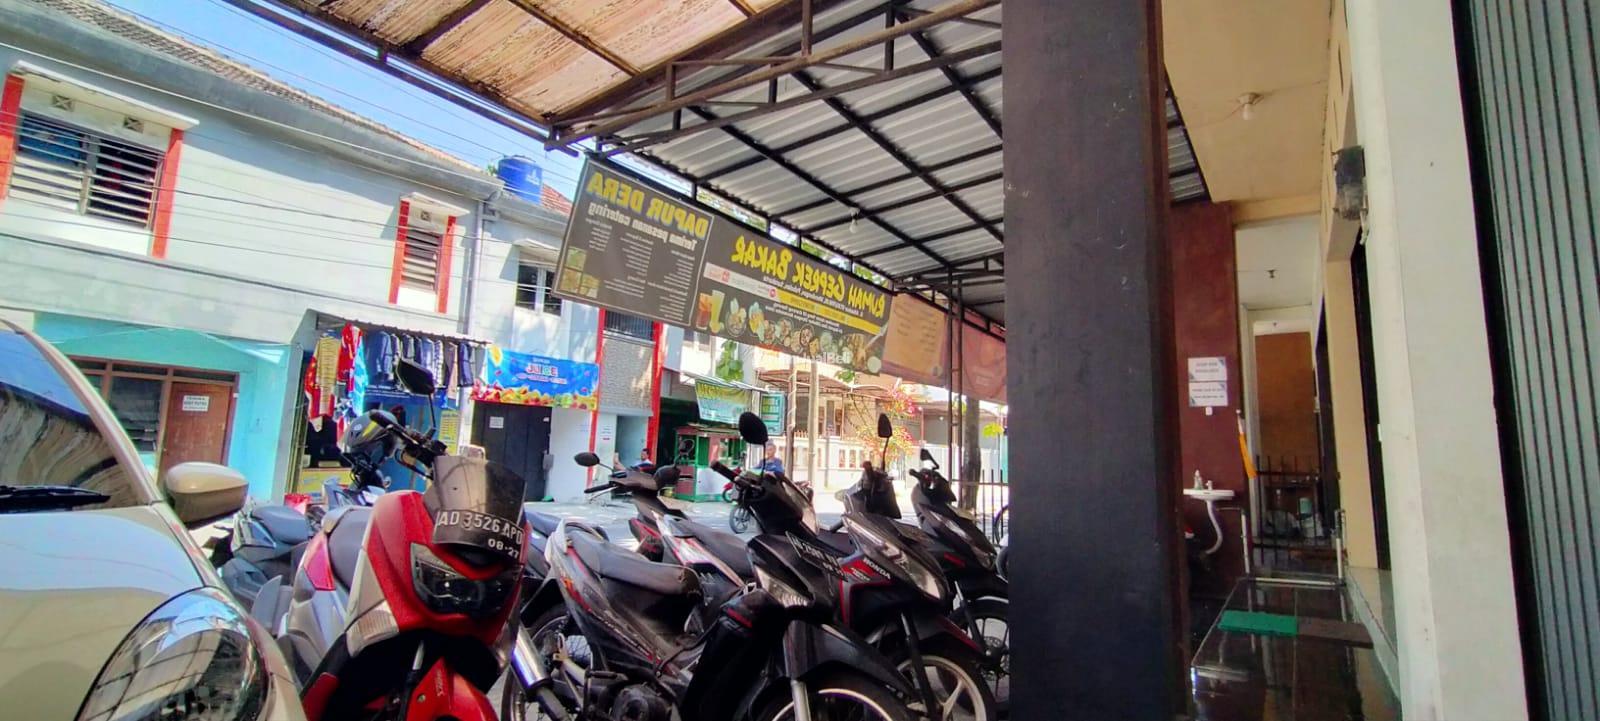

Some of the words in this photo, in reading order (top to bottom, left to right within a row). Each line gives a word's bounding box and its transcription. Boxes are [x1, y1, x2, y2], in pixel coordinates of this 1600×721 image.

[440, 511, 460, 526] AD
[462, 512, 501, 533] 3526
[862, 556, 892, 580] HONDA
